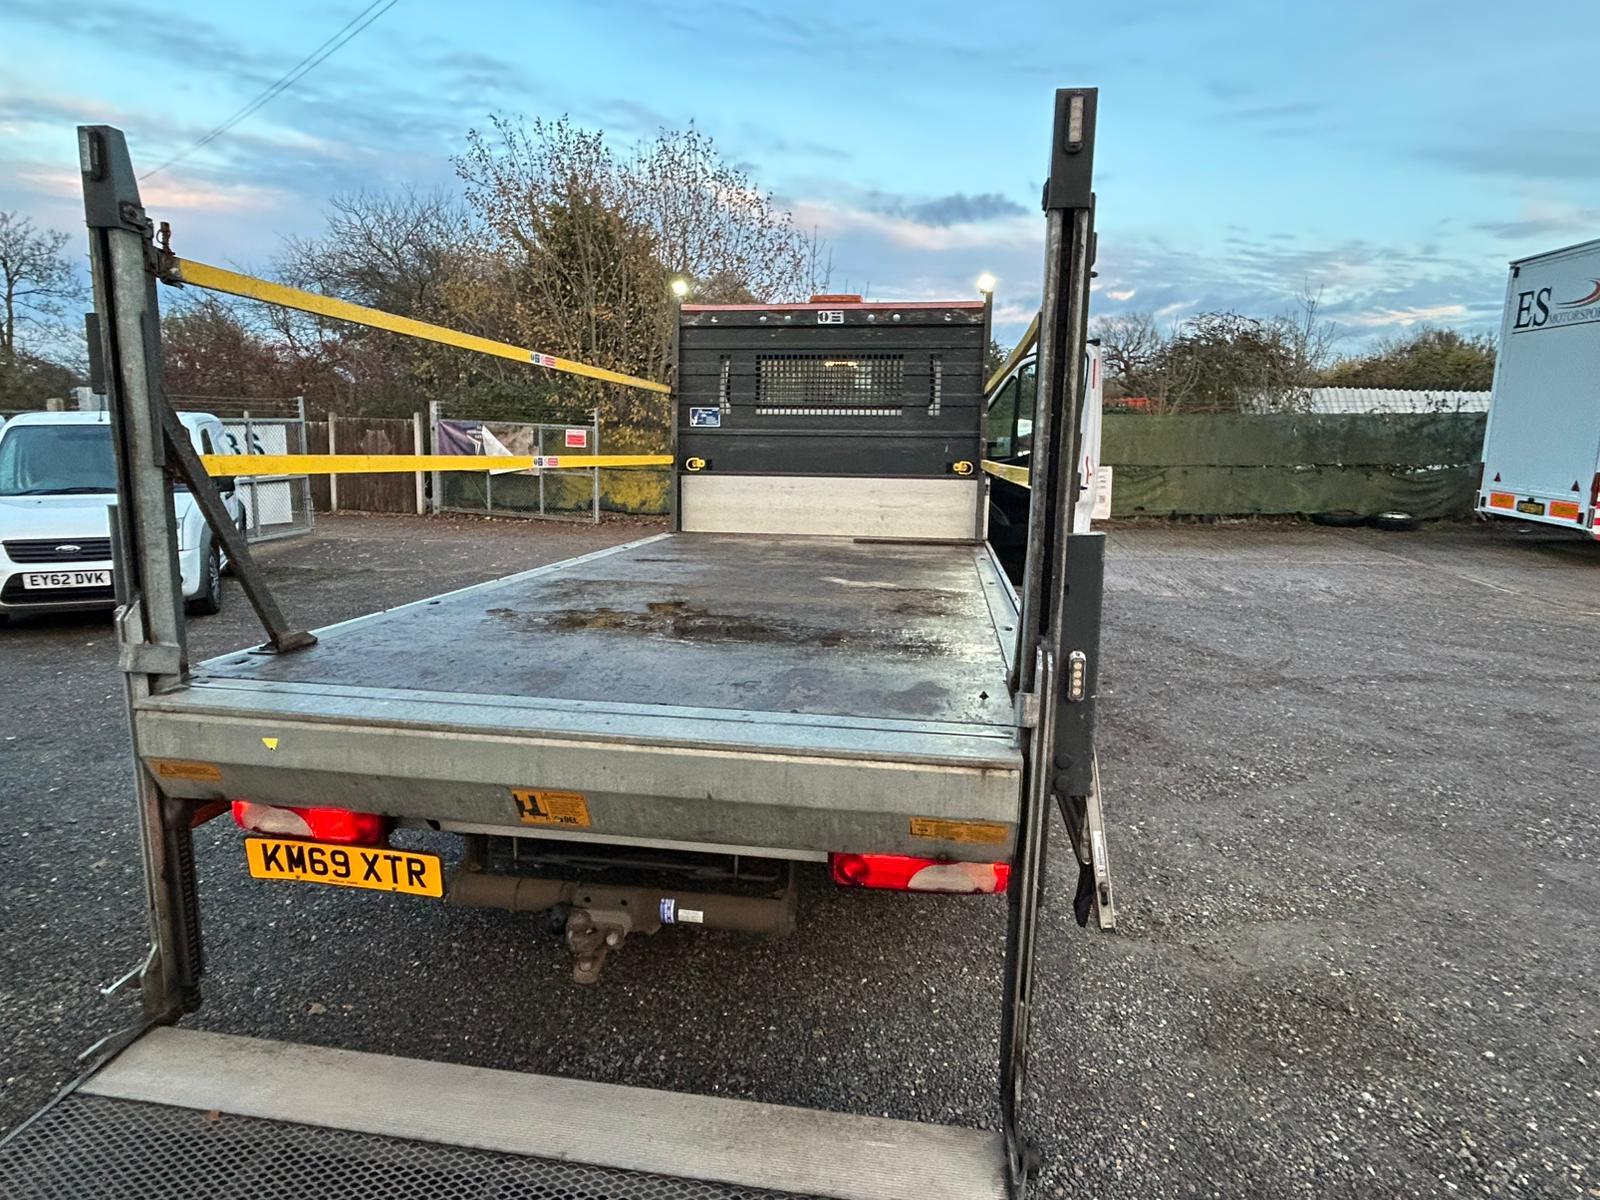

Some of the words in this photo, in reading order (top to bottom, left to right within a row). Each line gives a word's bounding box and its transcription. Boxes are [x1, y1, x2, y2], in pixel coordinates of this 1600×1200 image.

[1513, 286, 1552, 329] ES
[30, 573, 71, 586] EY62
[74, 572, 105, 585] DVK
[261, 843, 351, 879] KM69
[360, 852, 427, 889] XTR
